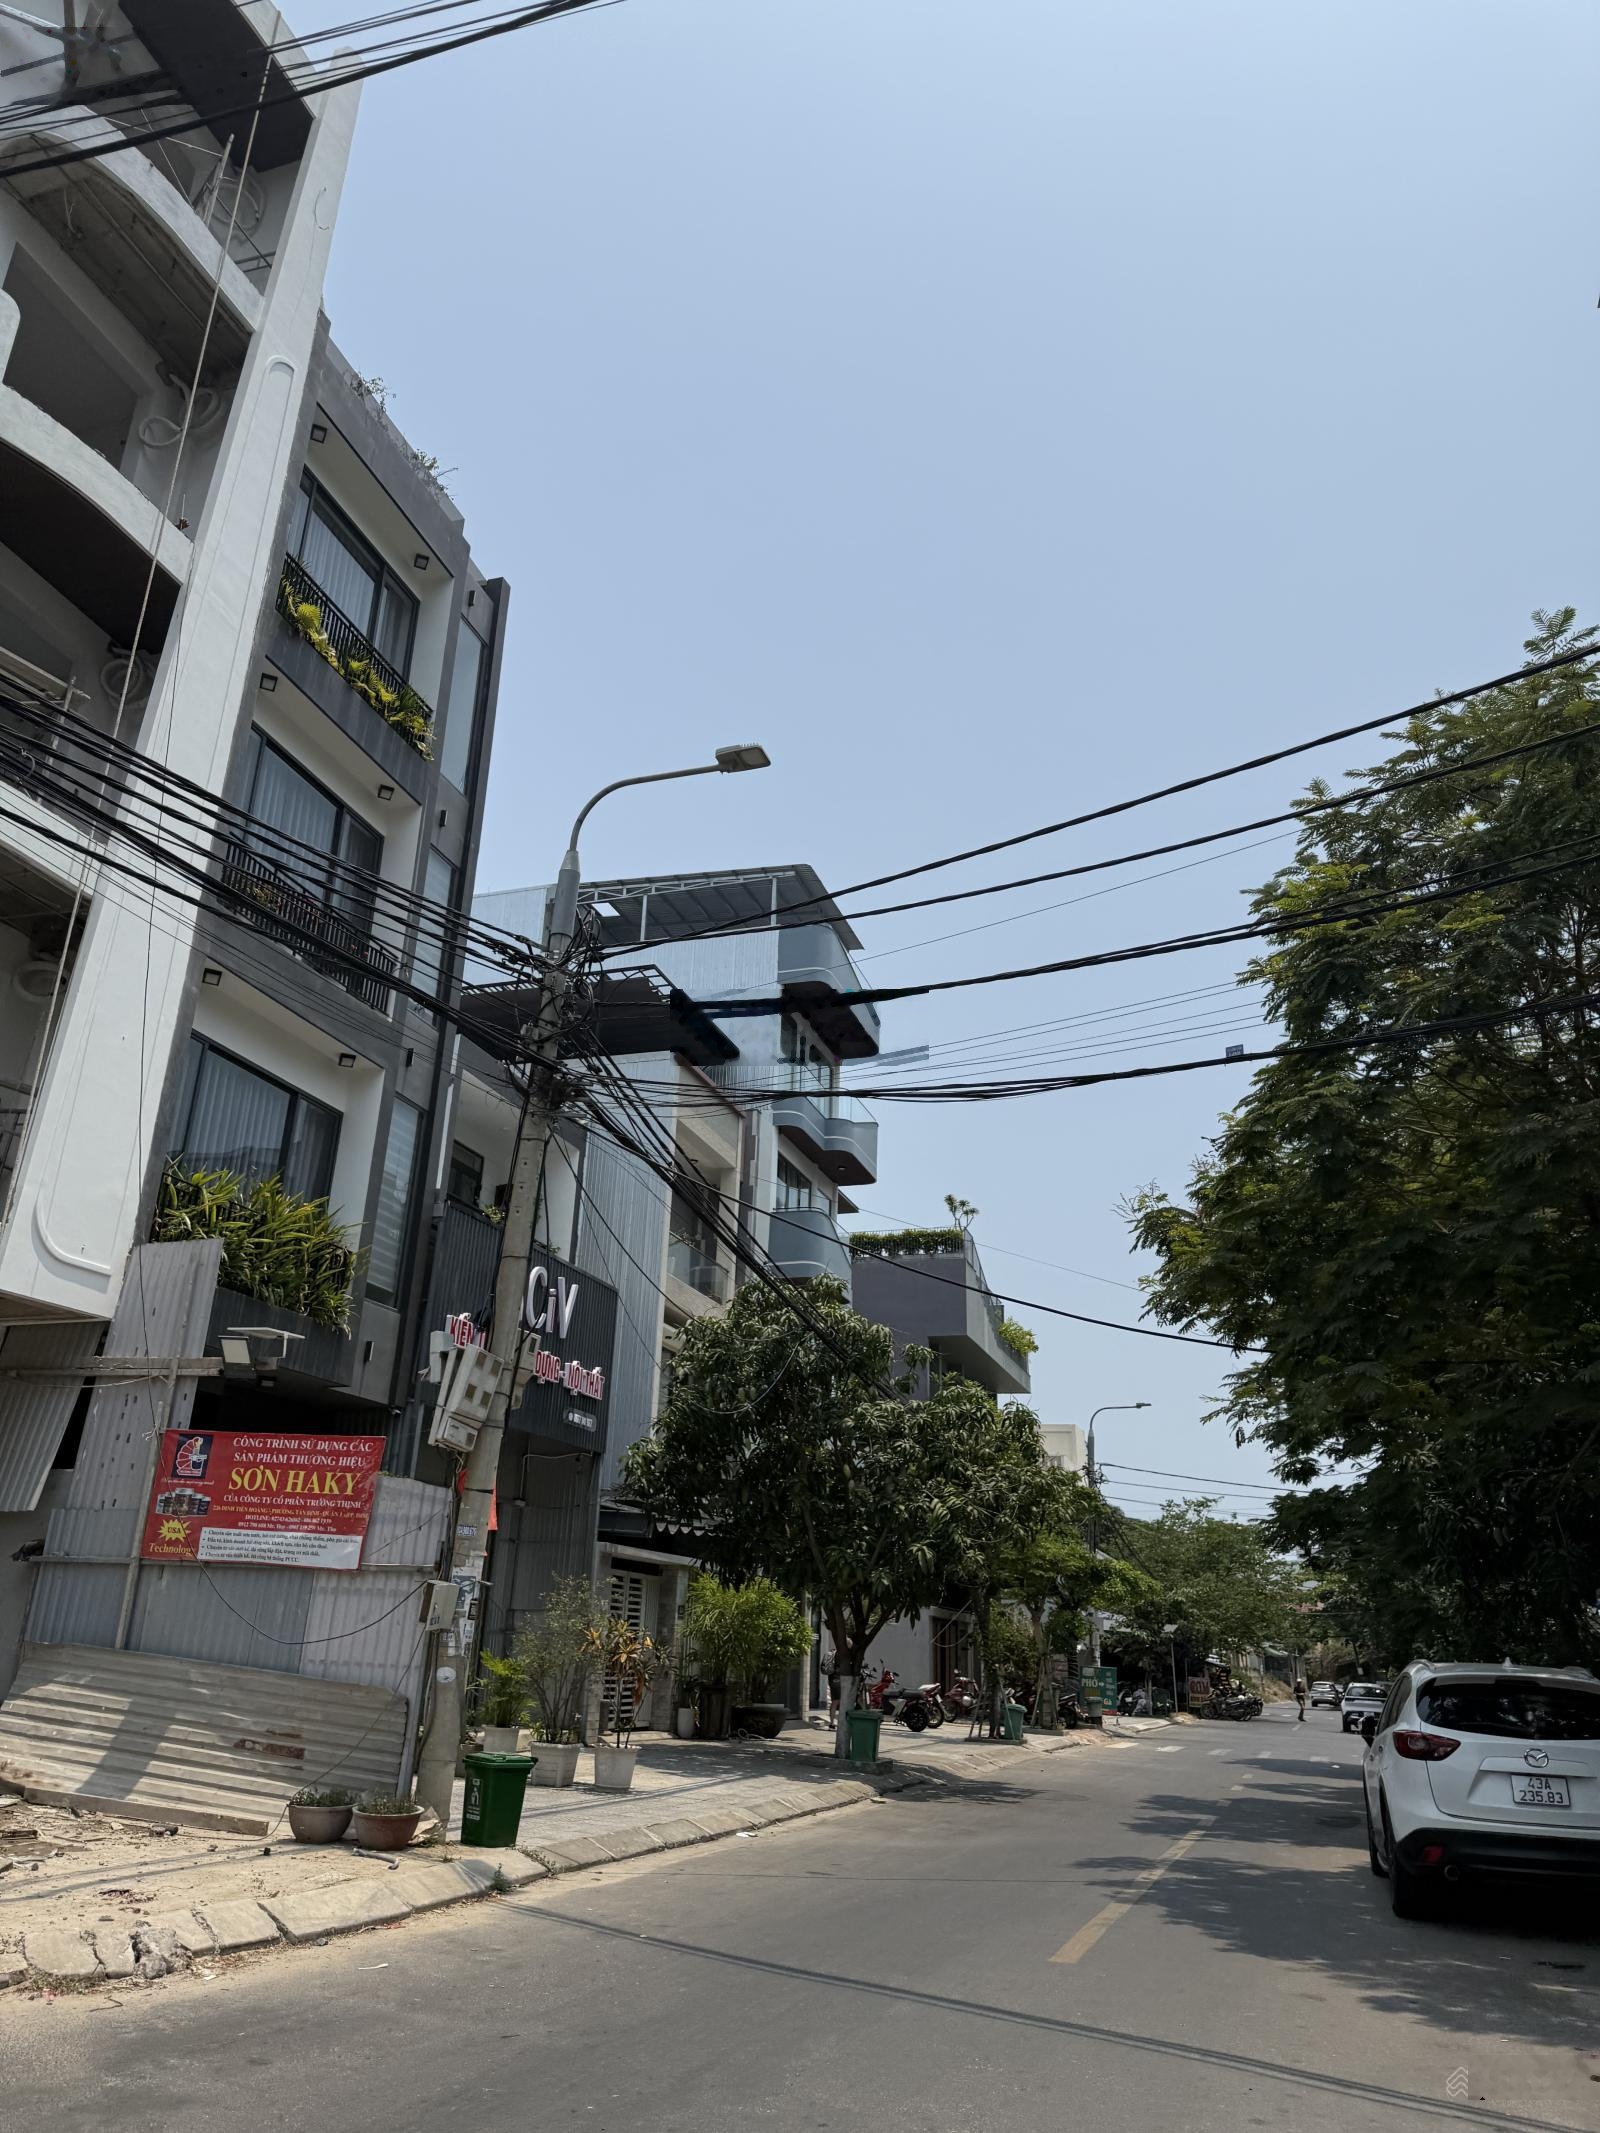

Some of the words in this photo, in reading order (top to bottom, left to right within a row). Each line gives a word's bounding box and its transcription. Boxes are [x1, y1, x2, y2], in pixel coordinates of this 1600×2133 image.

[233, 1435, 264, 1447] CÔNG
[265, 1437, 300, 1449] TRÌNH
[317, 1441, 348, 1453] DỤNG
[338, 1456, 366, 1469] HIỆU
[229, 1464, 281, 1492] SƠN
[240, 1495, 261, 1503] CÔNG
[1528, 1778, 1552, 1790] 43A
[1519, 1790, 1563, 1803] 235.83
